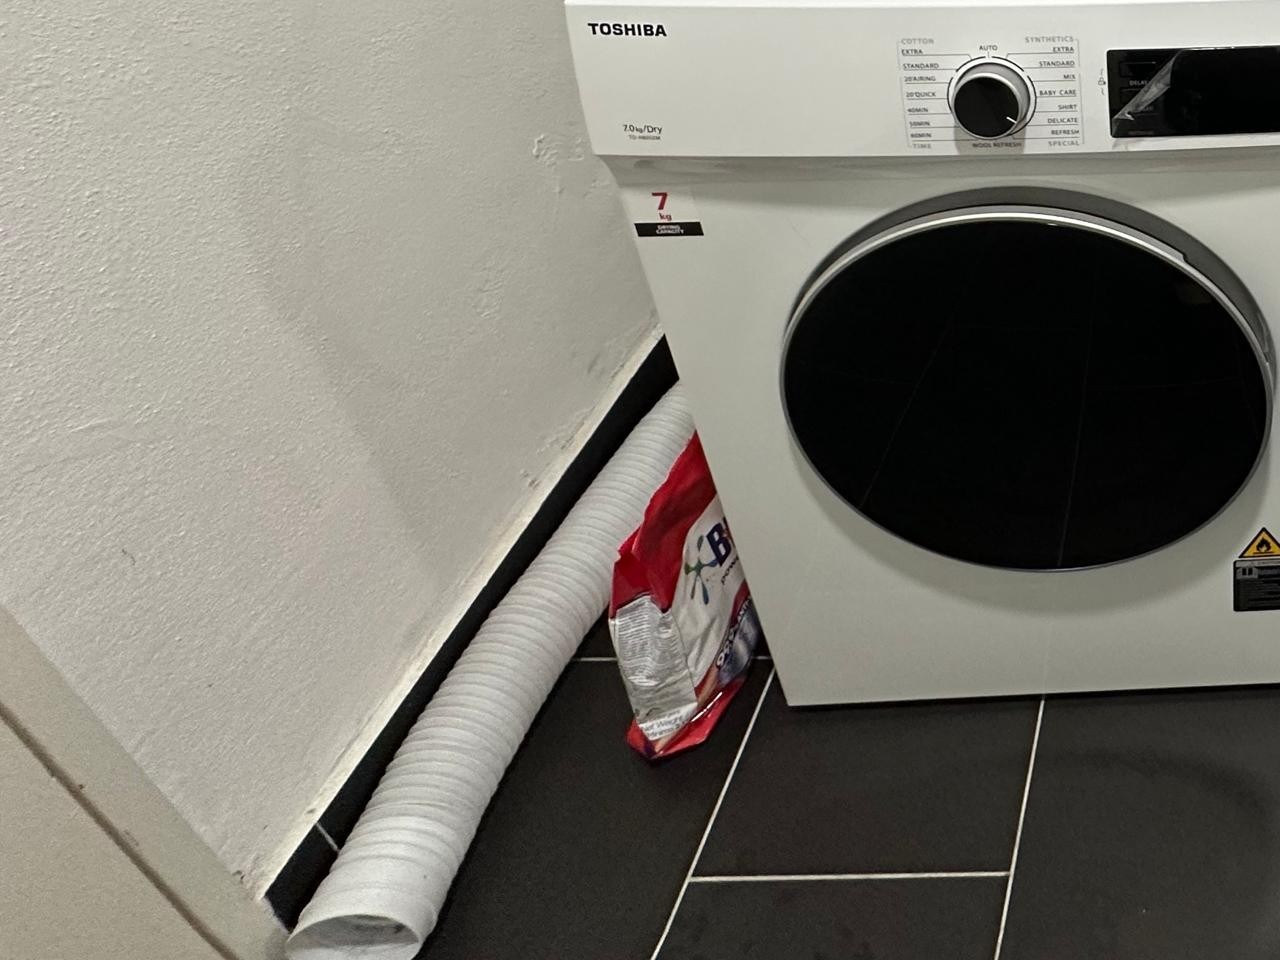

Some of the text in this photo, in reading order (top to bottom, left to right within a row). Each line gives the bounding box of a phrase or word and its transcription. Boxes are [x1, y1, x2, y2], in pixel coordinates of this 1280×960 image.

[587, 23, 667, 37] TOSHIBA
[652, 192, 668, 211] 7
[659, 213, 672, 221] kg
